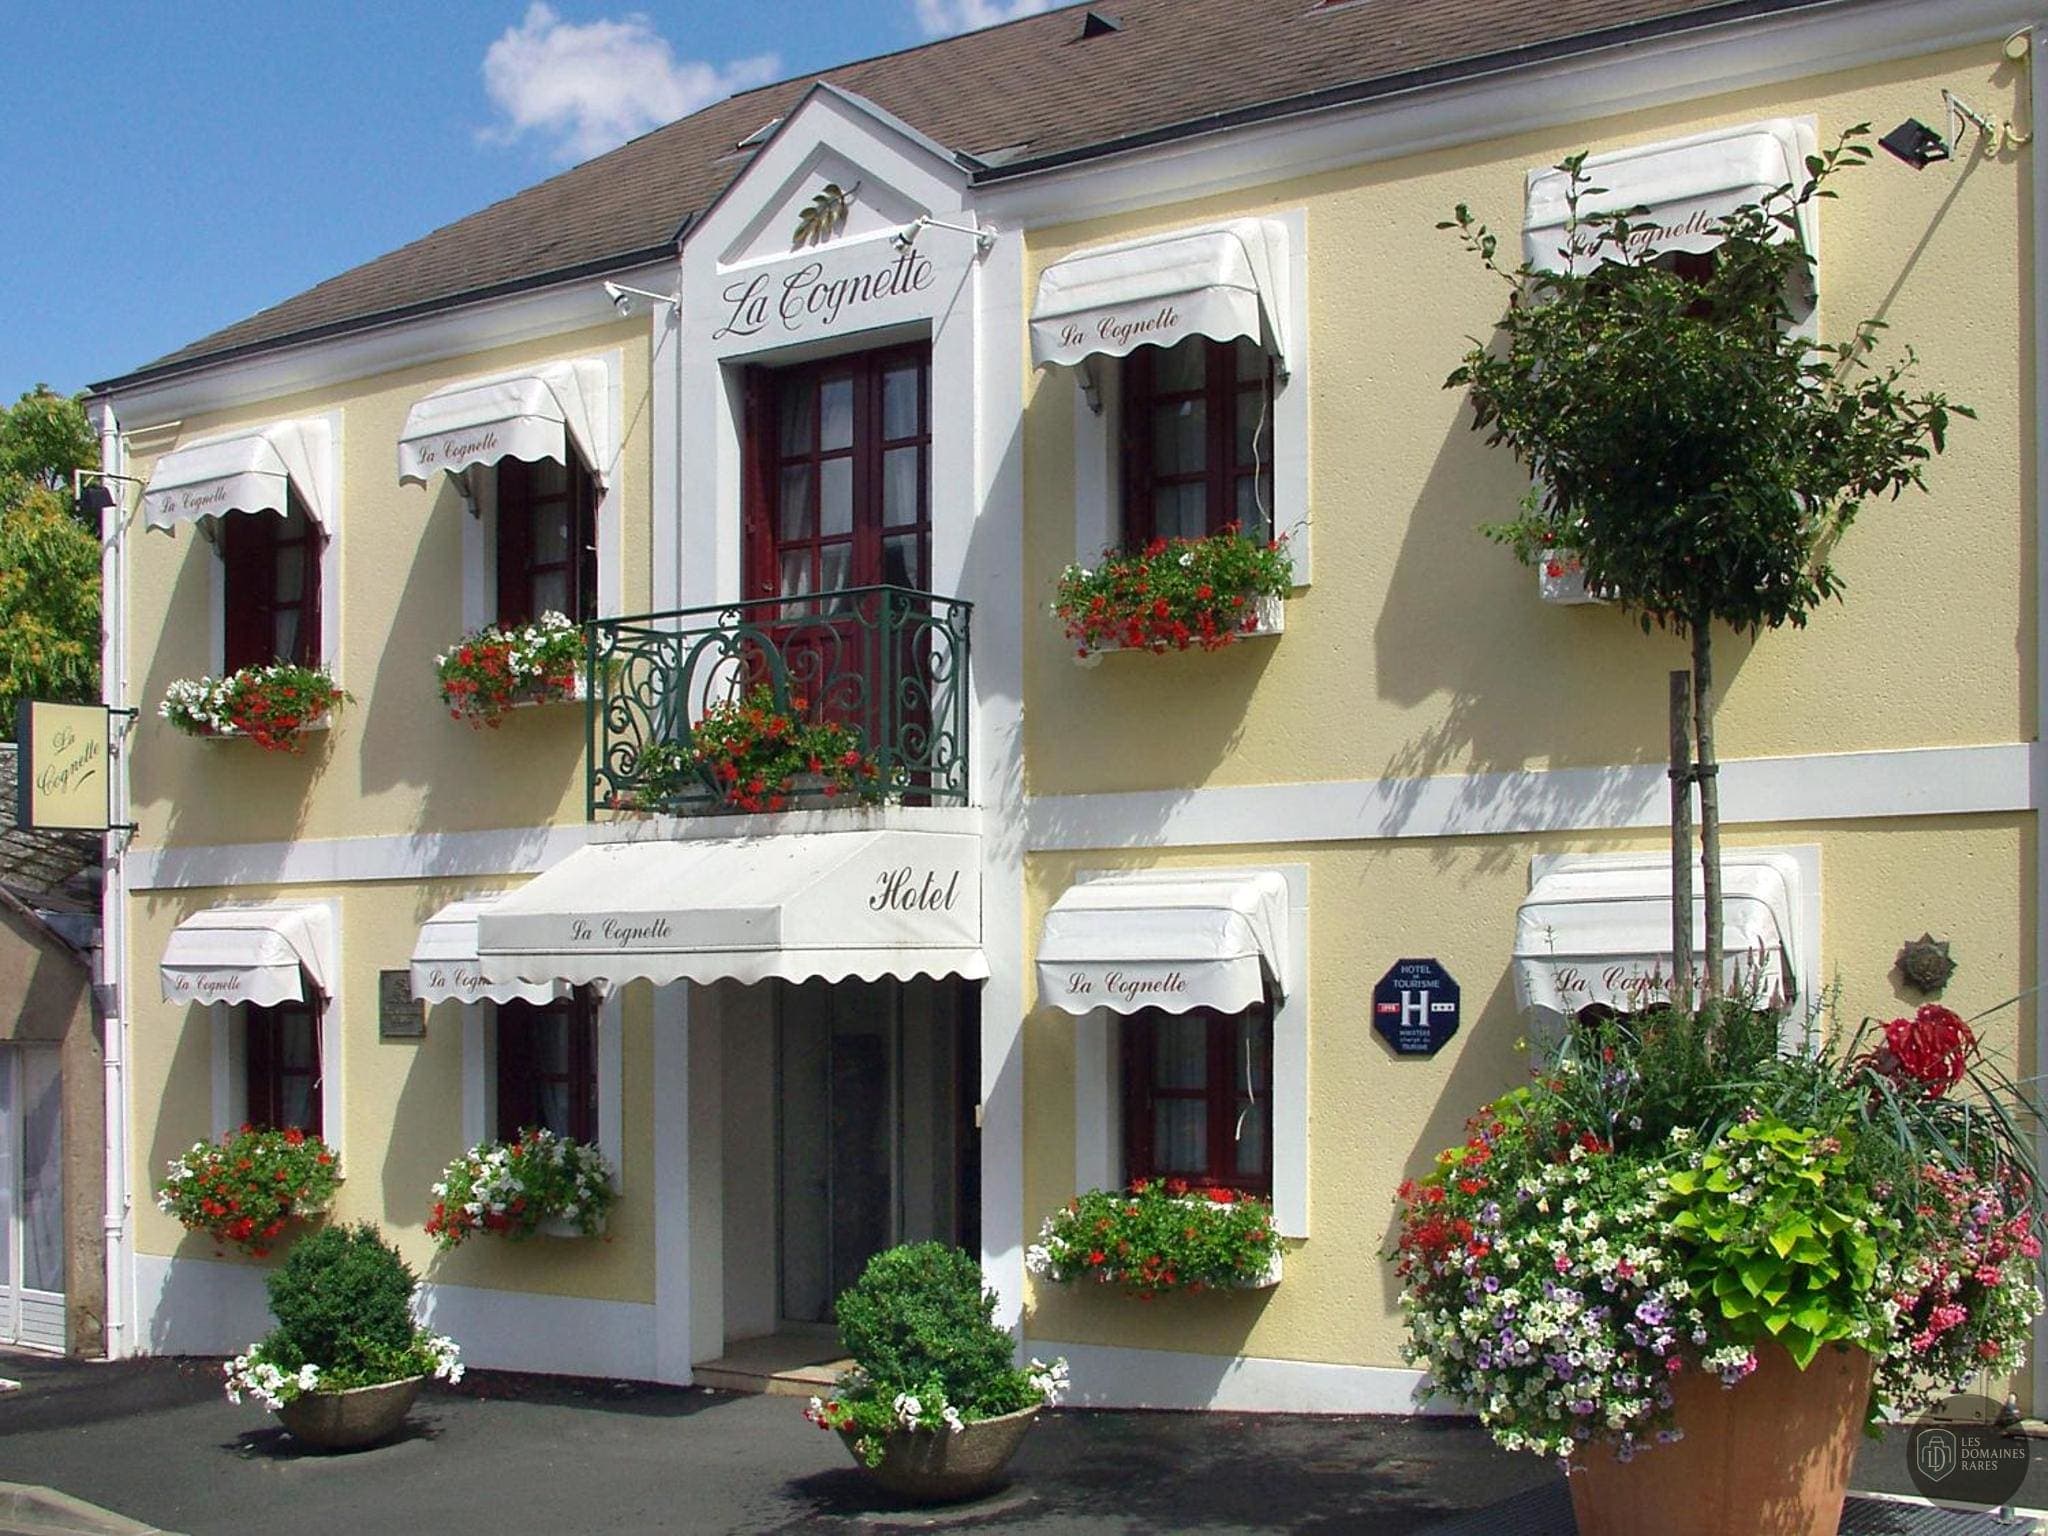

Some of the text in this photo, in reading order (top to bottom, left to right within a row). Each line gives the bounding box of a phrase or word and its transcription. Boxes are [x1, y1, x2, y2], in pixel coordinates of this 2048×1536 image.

[1615, 210, 1713, 251] ognette
[712, 249, 936, 340] La Cognette
[1058, 306, 1179, 347] La Cognette
[417, 432, 499, 465] La Cognette
[162, 486, 227, 513] La Cognette
[52, 726, 76, 757] La
[37, 739, 99, 797] Cognette
[869, 866, 960, 911] Hotel
[571, 918, 671, 948] La Cognette
[175, 975, 241, 995] La Cognette
[429, 970, 446, 988] La
[1394, 980, 1440, 989] TOURISME
[1401, 965, 1431, 974] HOTEL
[1556, 968, 1587, 992] La
[1066, 971, 1188, 1002] La Cognette
[1401, 990, 1430, 1027] H
